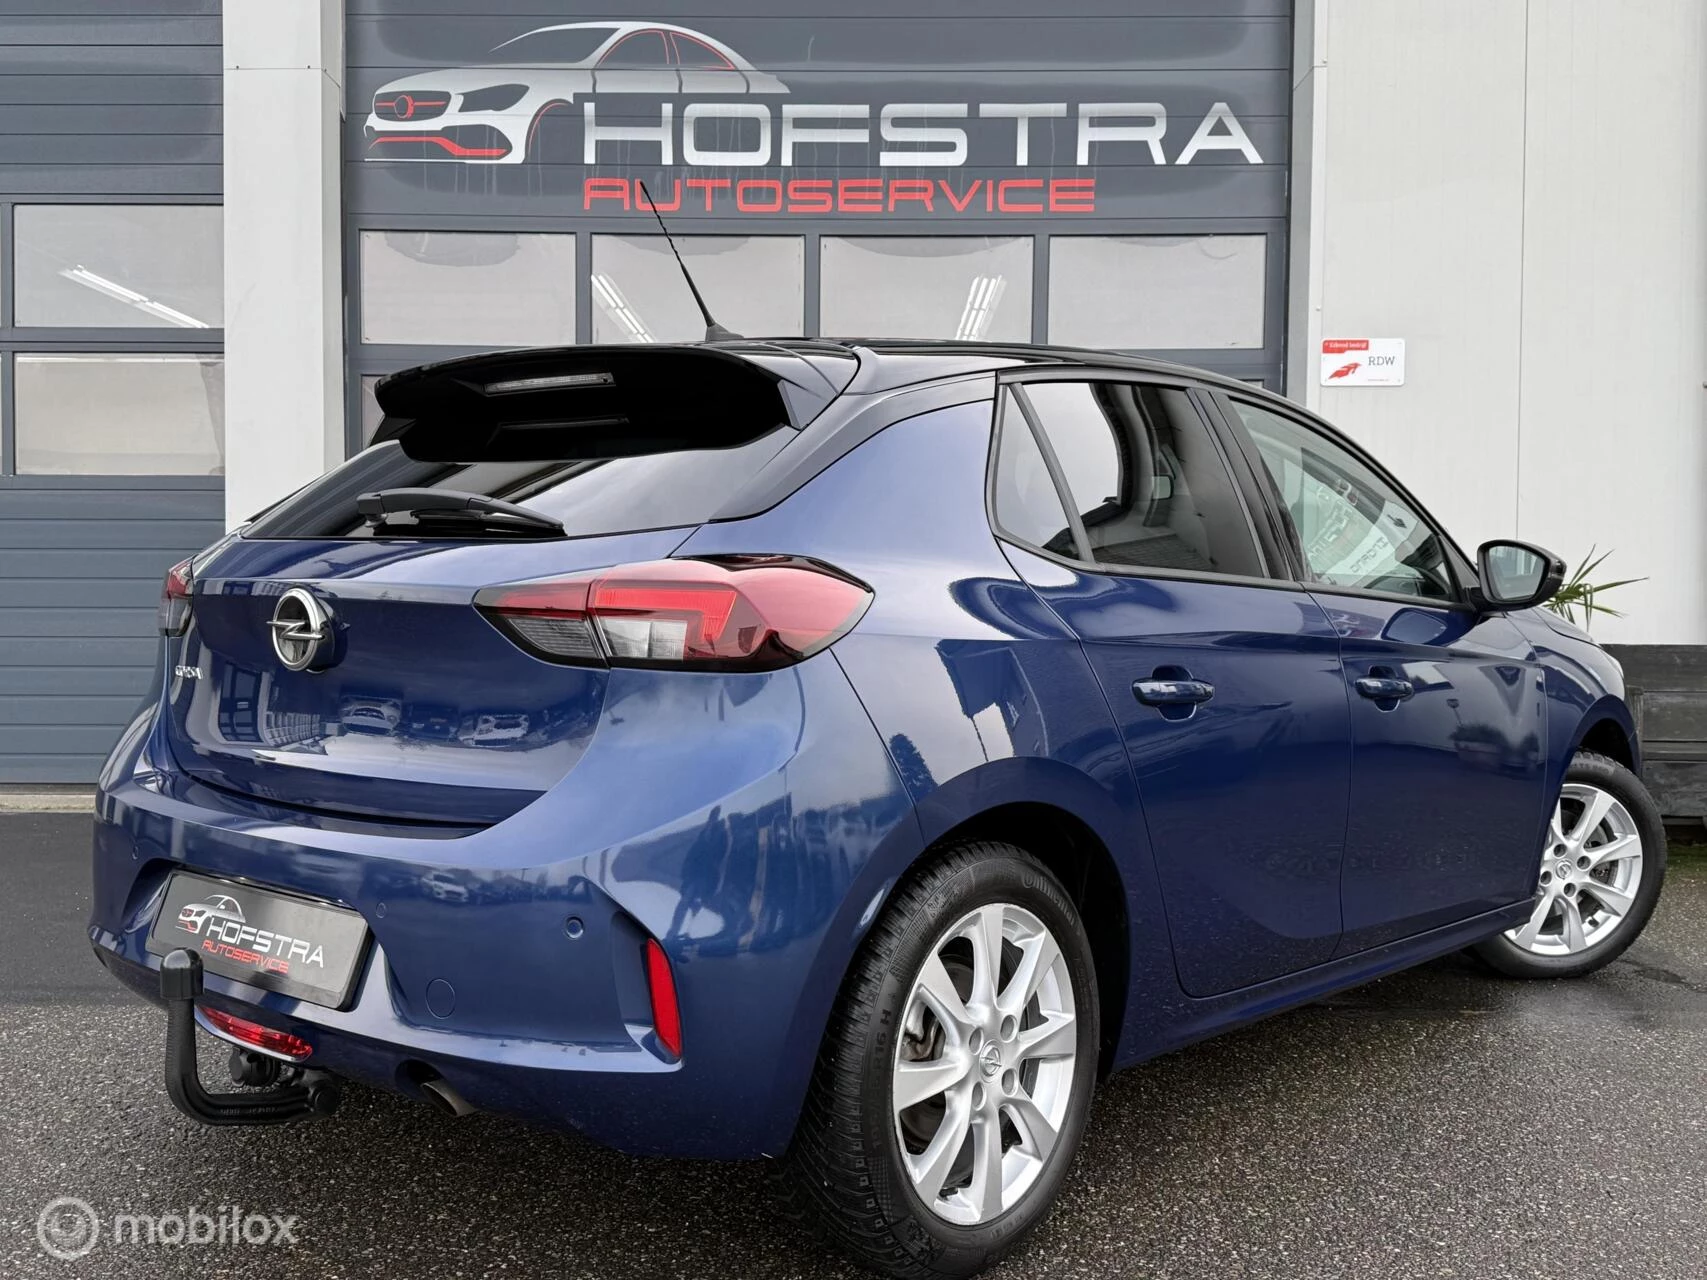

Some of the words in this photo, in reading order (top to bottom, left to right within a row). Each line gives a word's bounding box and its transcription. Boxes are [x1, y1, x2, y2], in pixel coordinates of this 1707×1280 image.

[584, 102, 1263, 167] HOFSTRA
[583, 178, 1096, 213] AUTOSERVICE
[1368, 355, 1396, 367] RDW
[201, 938, 290, 975] AUTOSERVICE
[206, 917, 325, 969] HOFSTRA
